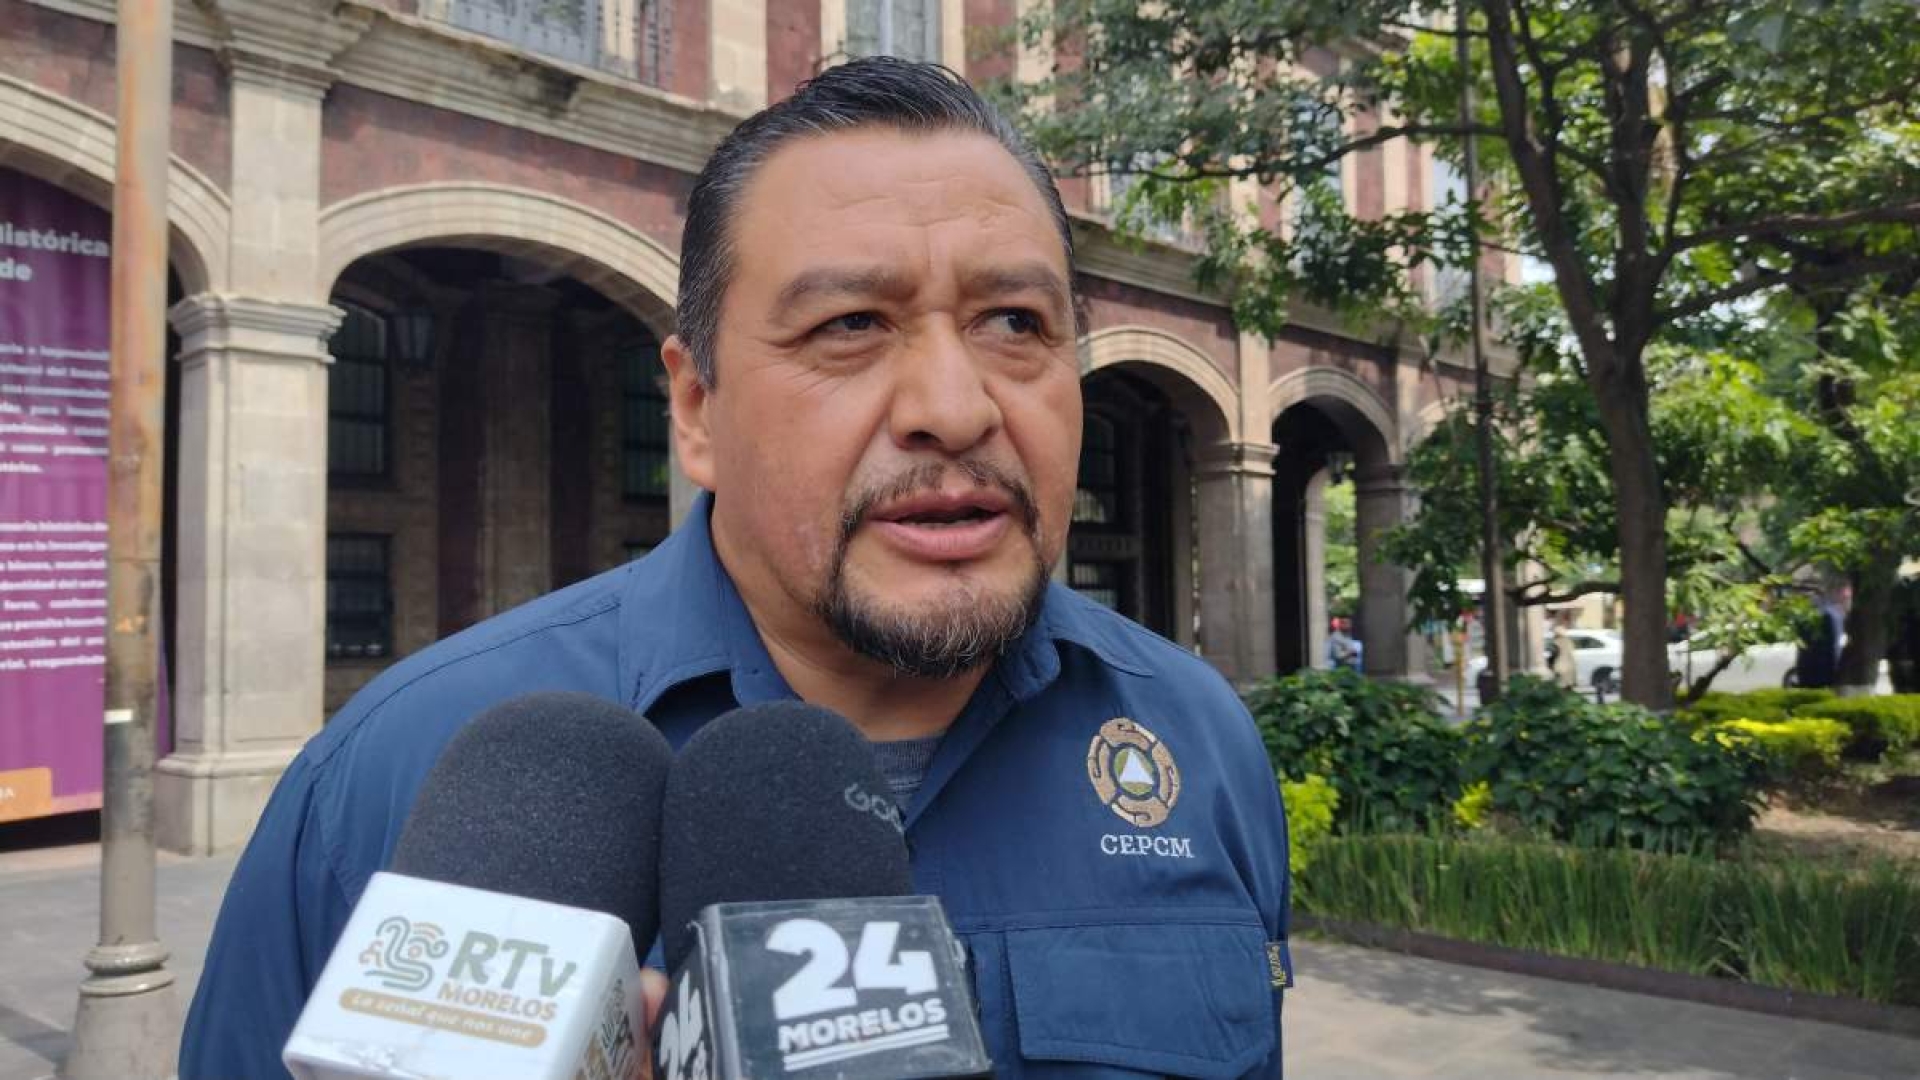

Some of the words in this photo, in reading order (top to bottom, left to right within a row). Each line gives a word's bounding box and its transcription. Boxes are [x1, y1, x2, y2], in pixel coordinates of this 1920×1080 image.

[0, 258, 32, 282] de
[1100, 834, 1195, 858] CEPCM
[765, 918, 939, 1020] 24
[437, 981, 559, 1022] MORELOS
[778, 997, 948, 1053] MORELOS
